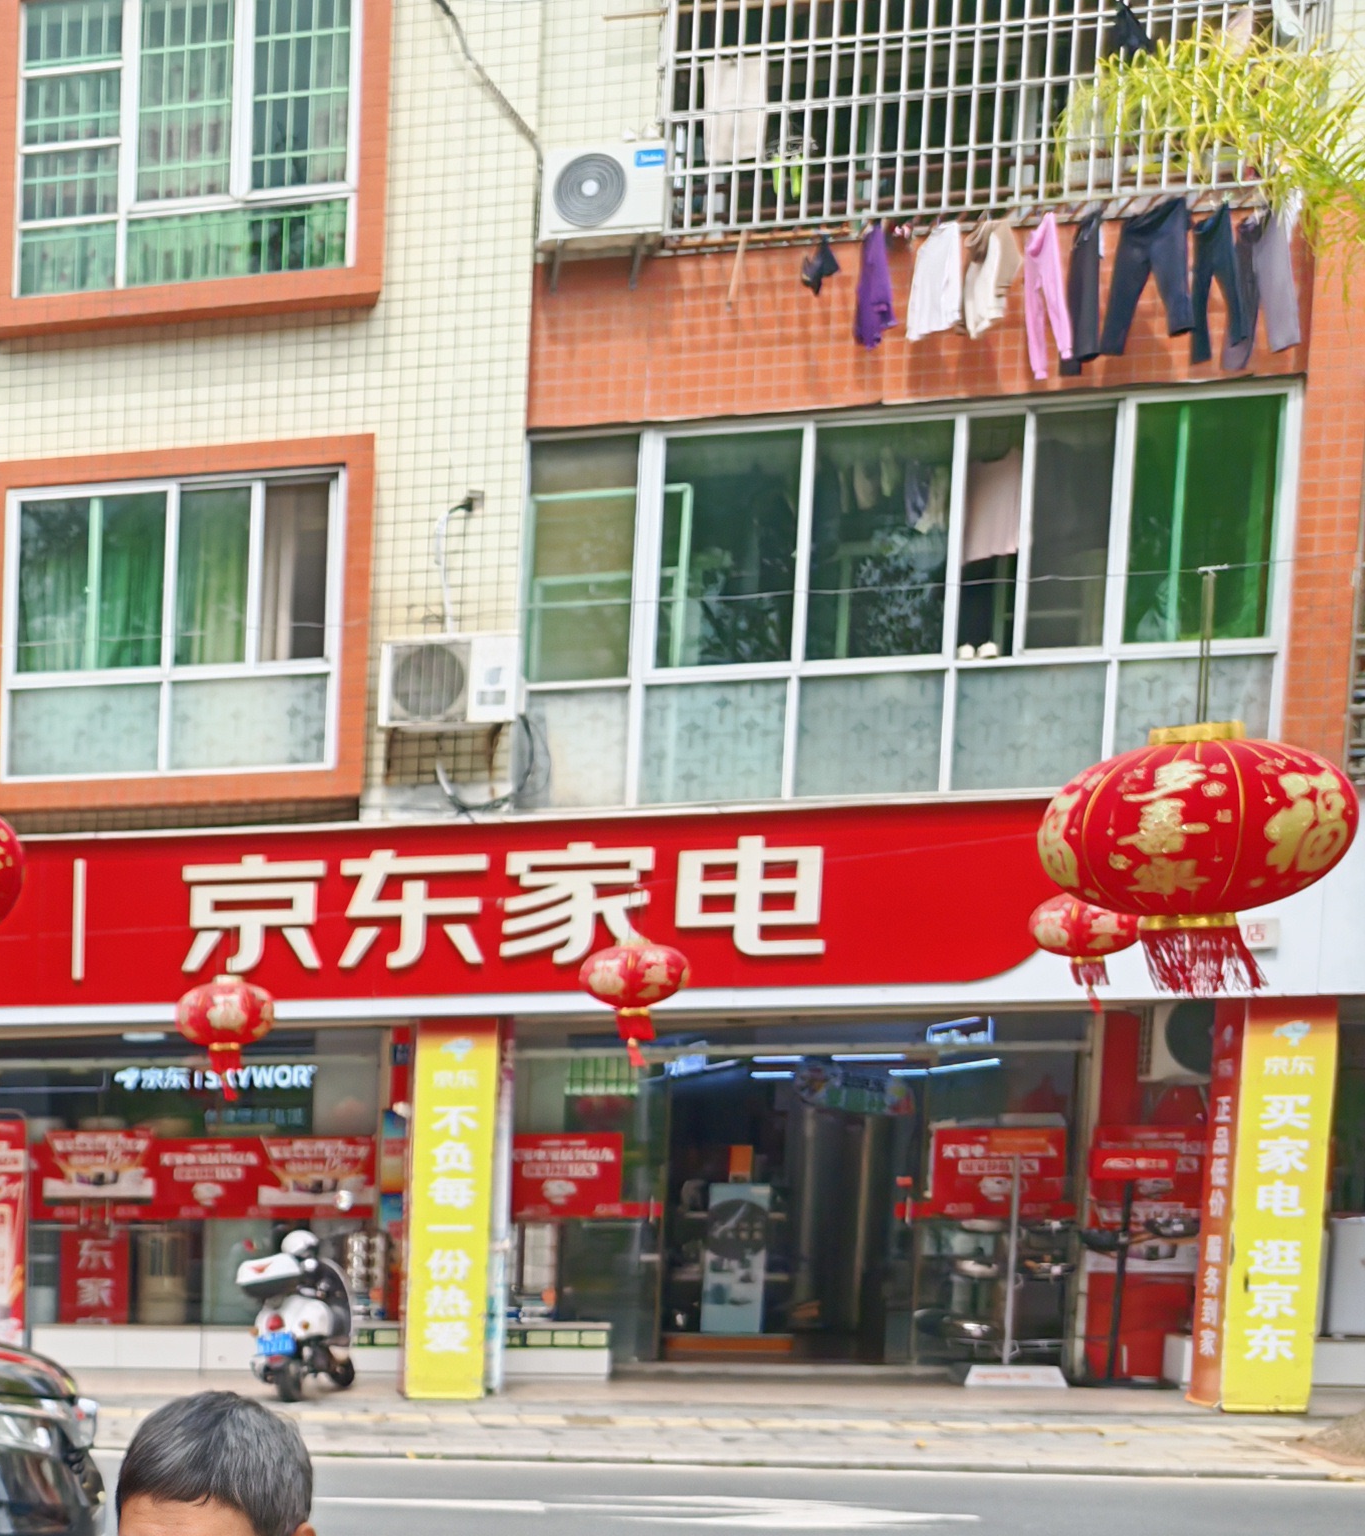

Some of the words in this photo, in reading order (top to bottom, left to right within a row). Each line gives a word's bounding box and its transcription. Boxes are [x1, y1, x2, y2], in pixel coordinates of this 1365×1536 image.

[181, 836, 826, 973] 京东家电
[141, 1066, 191, 1090] 京东
[204, 1065, 318, 1089] SYWOR
[1262, 1055, 1315, 1076] 京东
[1207, 1095, 1232, 1218] 正品低价
[1254, 1094, 1311, 1218] 买家电
[424, 1104, 478, 1354] 不负每一份热爱
[1199, 1234, 1223, 1357] 服务到家
[1243, 1239, 1302, 1363] 逛京东
